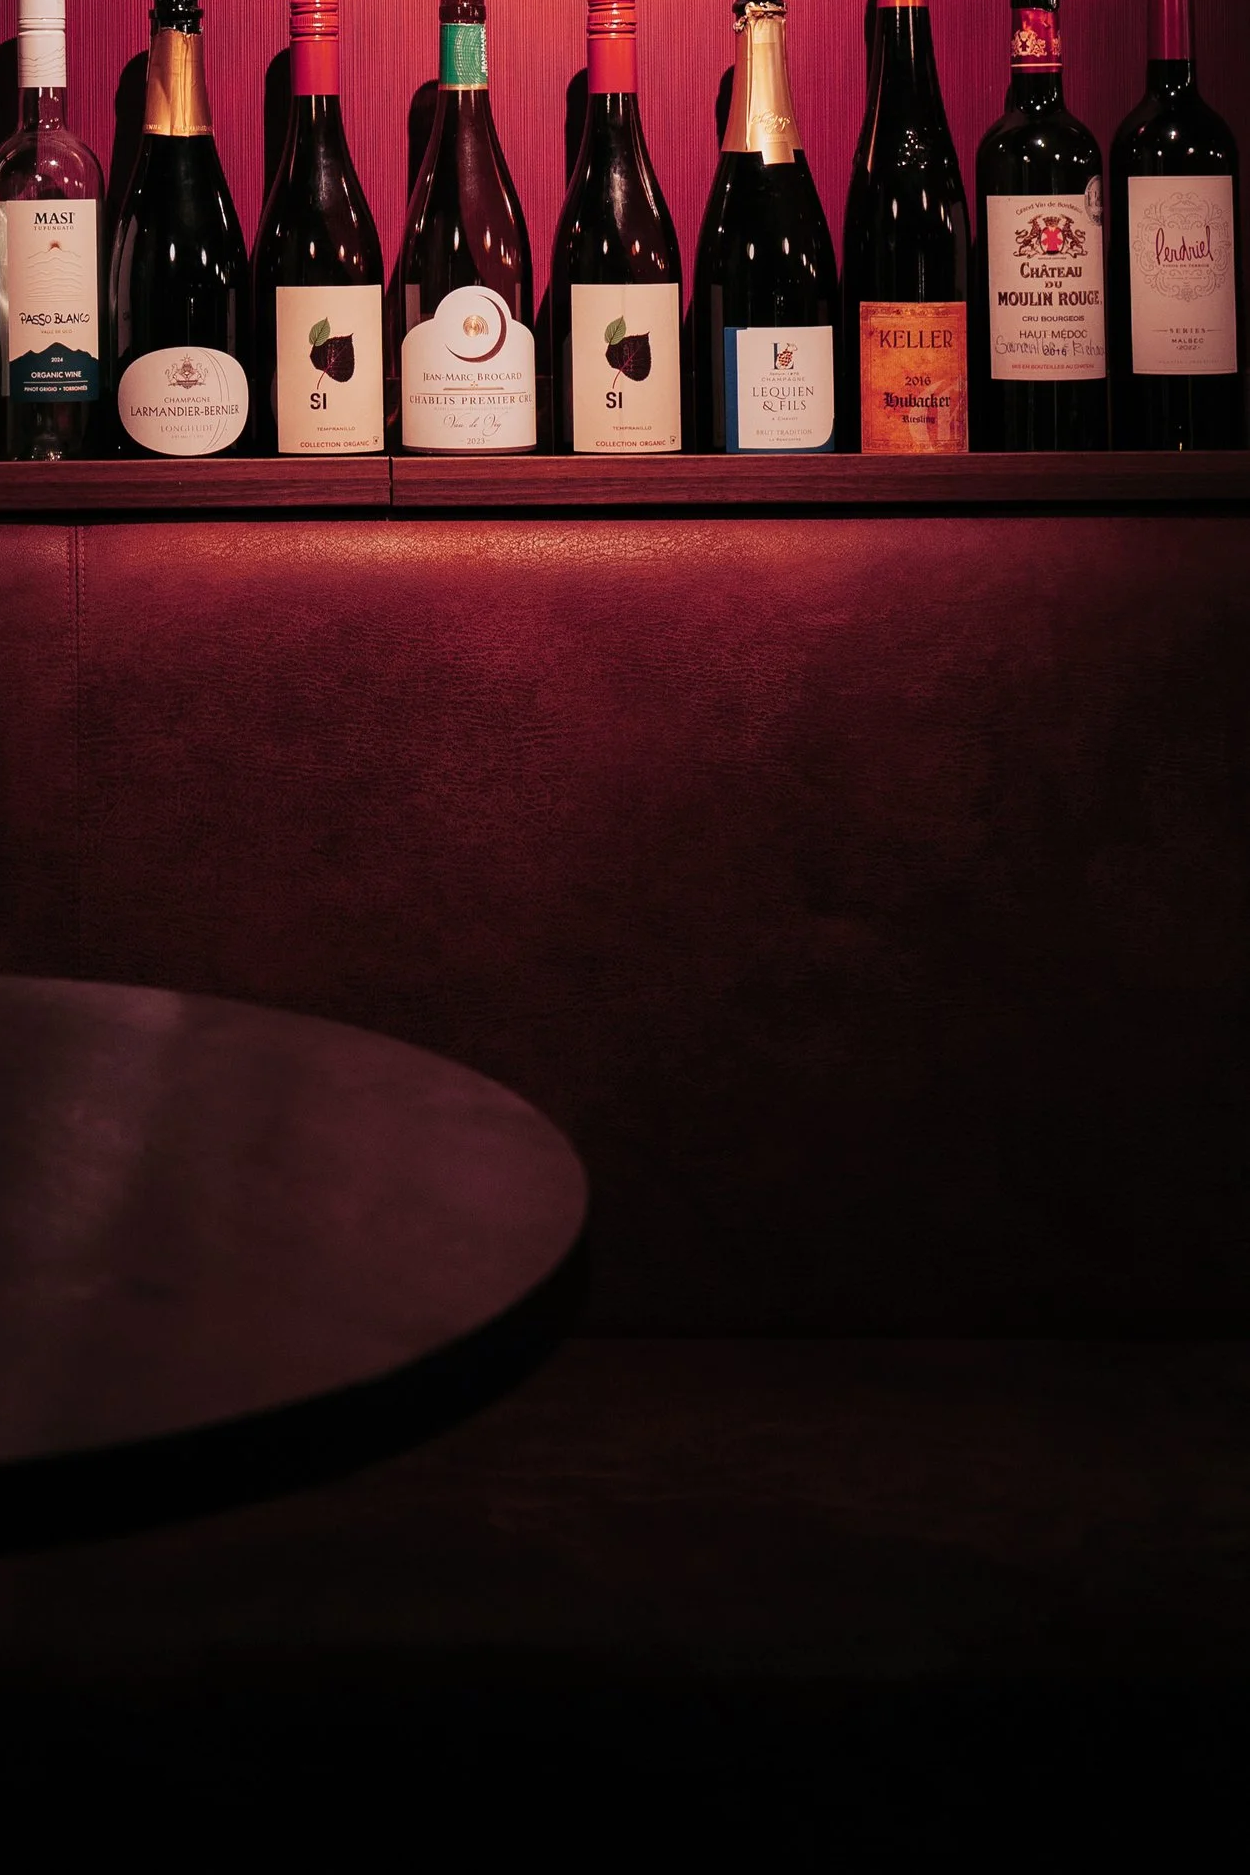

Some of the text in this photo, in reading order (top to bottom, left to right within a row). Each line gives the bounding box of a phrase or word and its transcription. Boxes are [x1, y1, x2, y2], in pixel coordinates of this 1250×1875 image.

[33, 212, 74, 225] MASI
[1044, 281, 1063, 289] DU
[997, 291, 1054, 306] MOULIN
[18, 312, 91, 326] PASSO BLANCO
[879, 329, 953, 349] KELLER
[30, 370, 82, 379] ORGANIC WINE
[423, 372, 522, 382] JEAN-MARC BROCARD
[904, 375, 932, 386] 2016
[752, 385, 814, 400] LEQUIEN
[163, 396, 211, 404] CHAMPAGNE
[310, 392, 327, 410] SI
[409, 395, 456, 405] CHABLIS
[461, 395, 516, 405] PREMIER
[605, 391, 623, 409] SI
[762, 400, 807, 413] & FILS
[130, 404, 240, 417] LARMANDIER-BERNIER
[160, 424, 214, 433] LONGITUDE
[639, 439, 666, 447] ORGANIC
